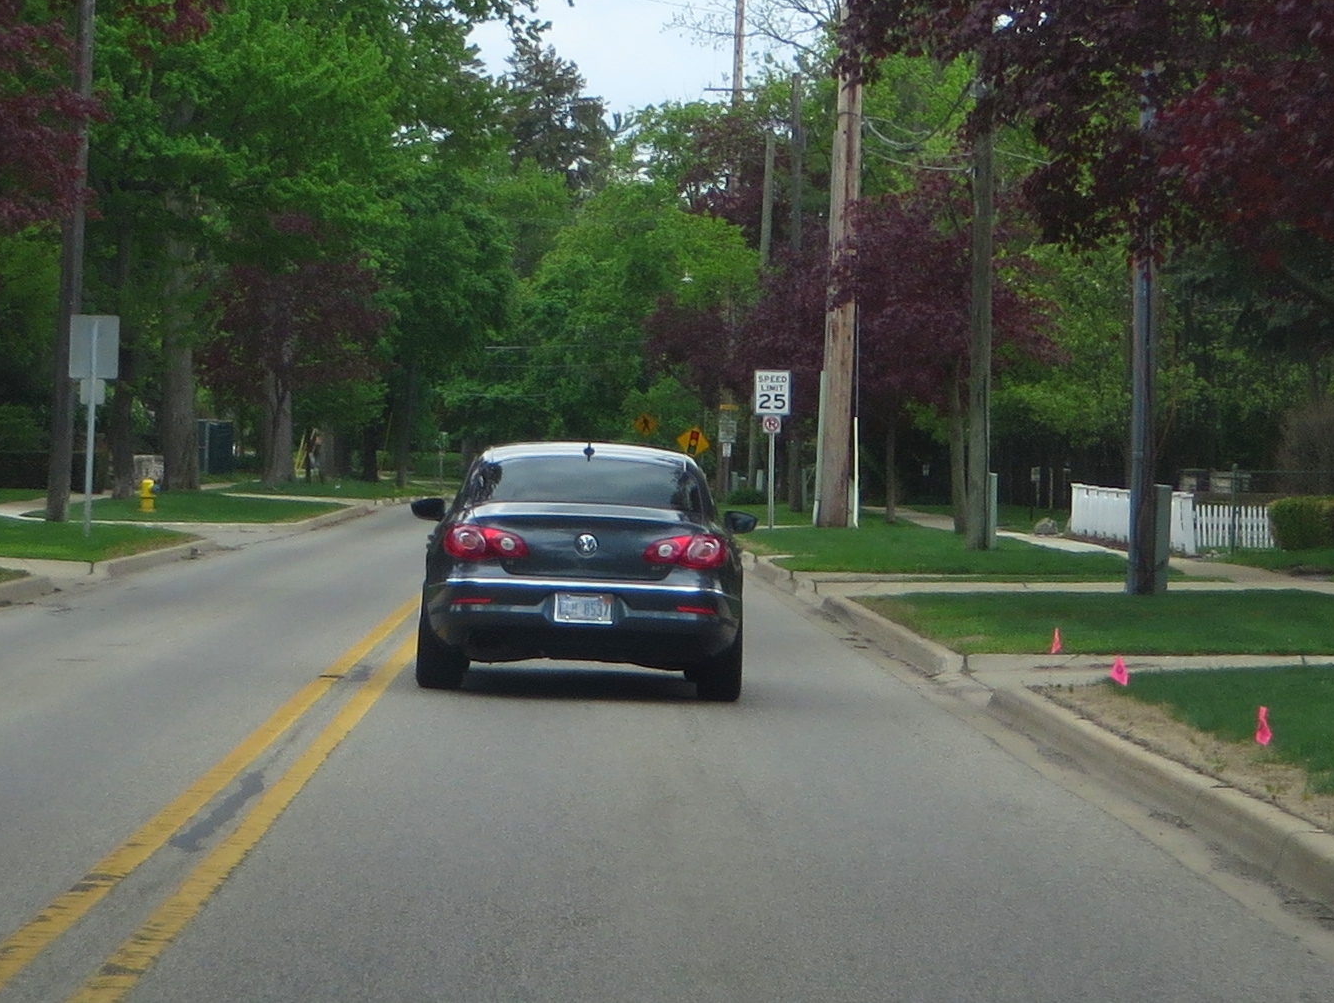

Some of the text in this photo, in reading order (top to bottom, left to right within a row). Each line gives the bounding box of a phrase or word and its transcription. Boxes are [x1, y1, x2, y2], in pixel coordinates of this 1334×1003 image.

[758, 375, 788, 383] SPEED
[760, 384, 784, 392] LIMIT
[758, 393, 786, 410] 25
